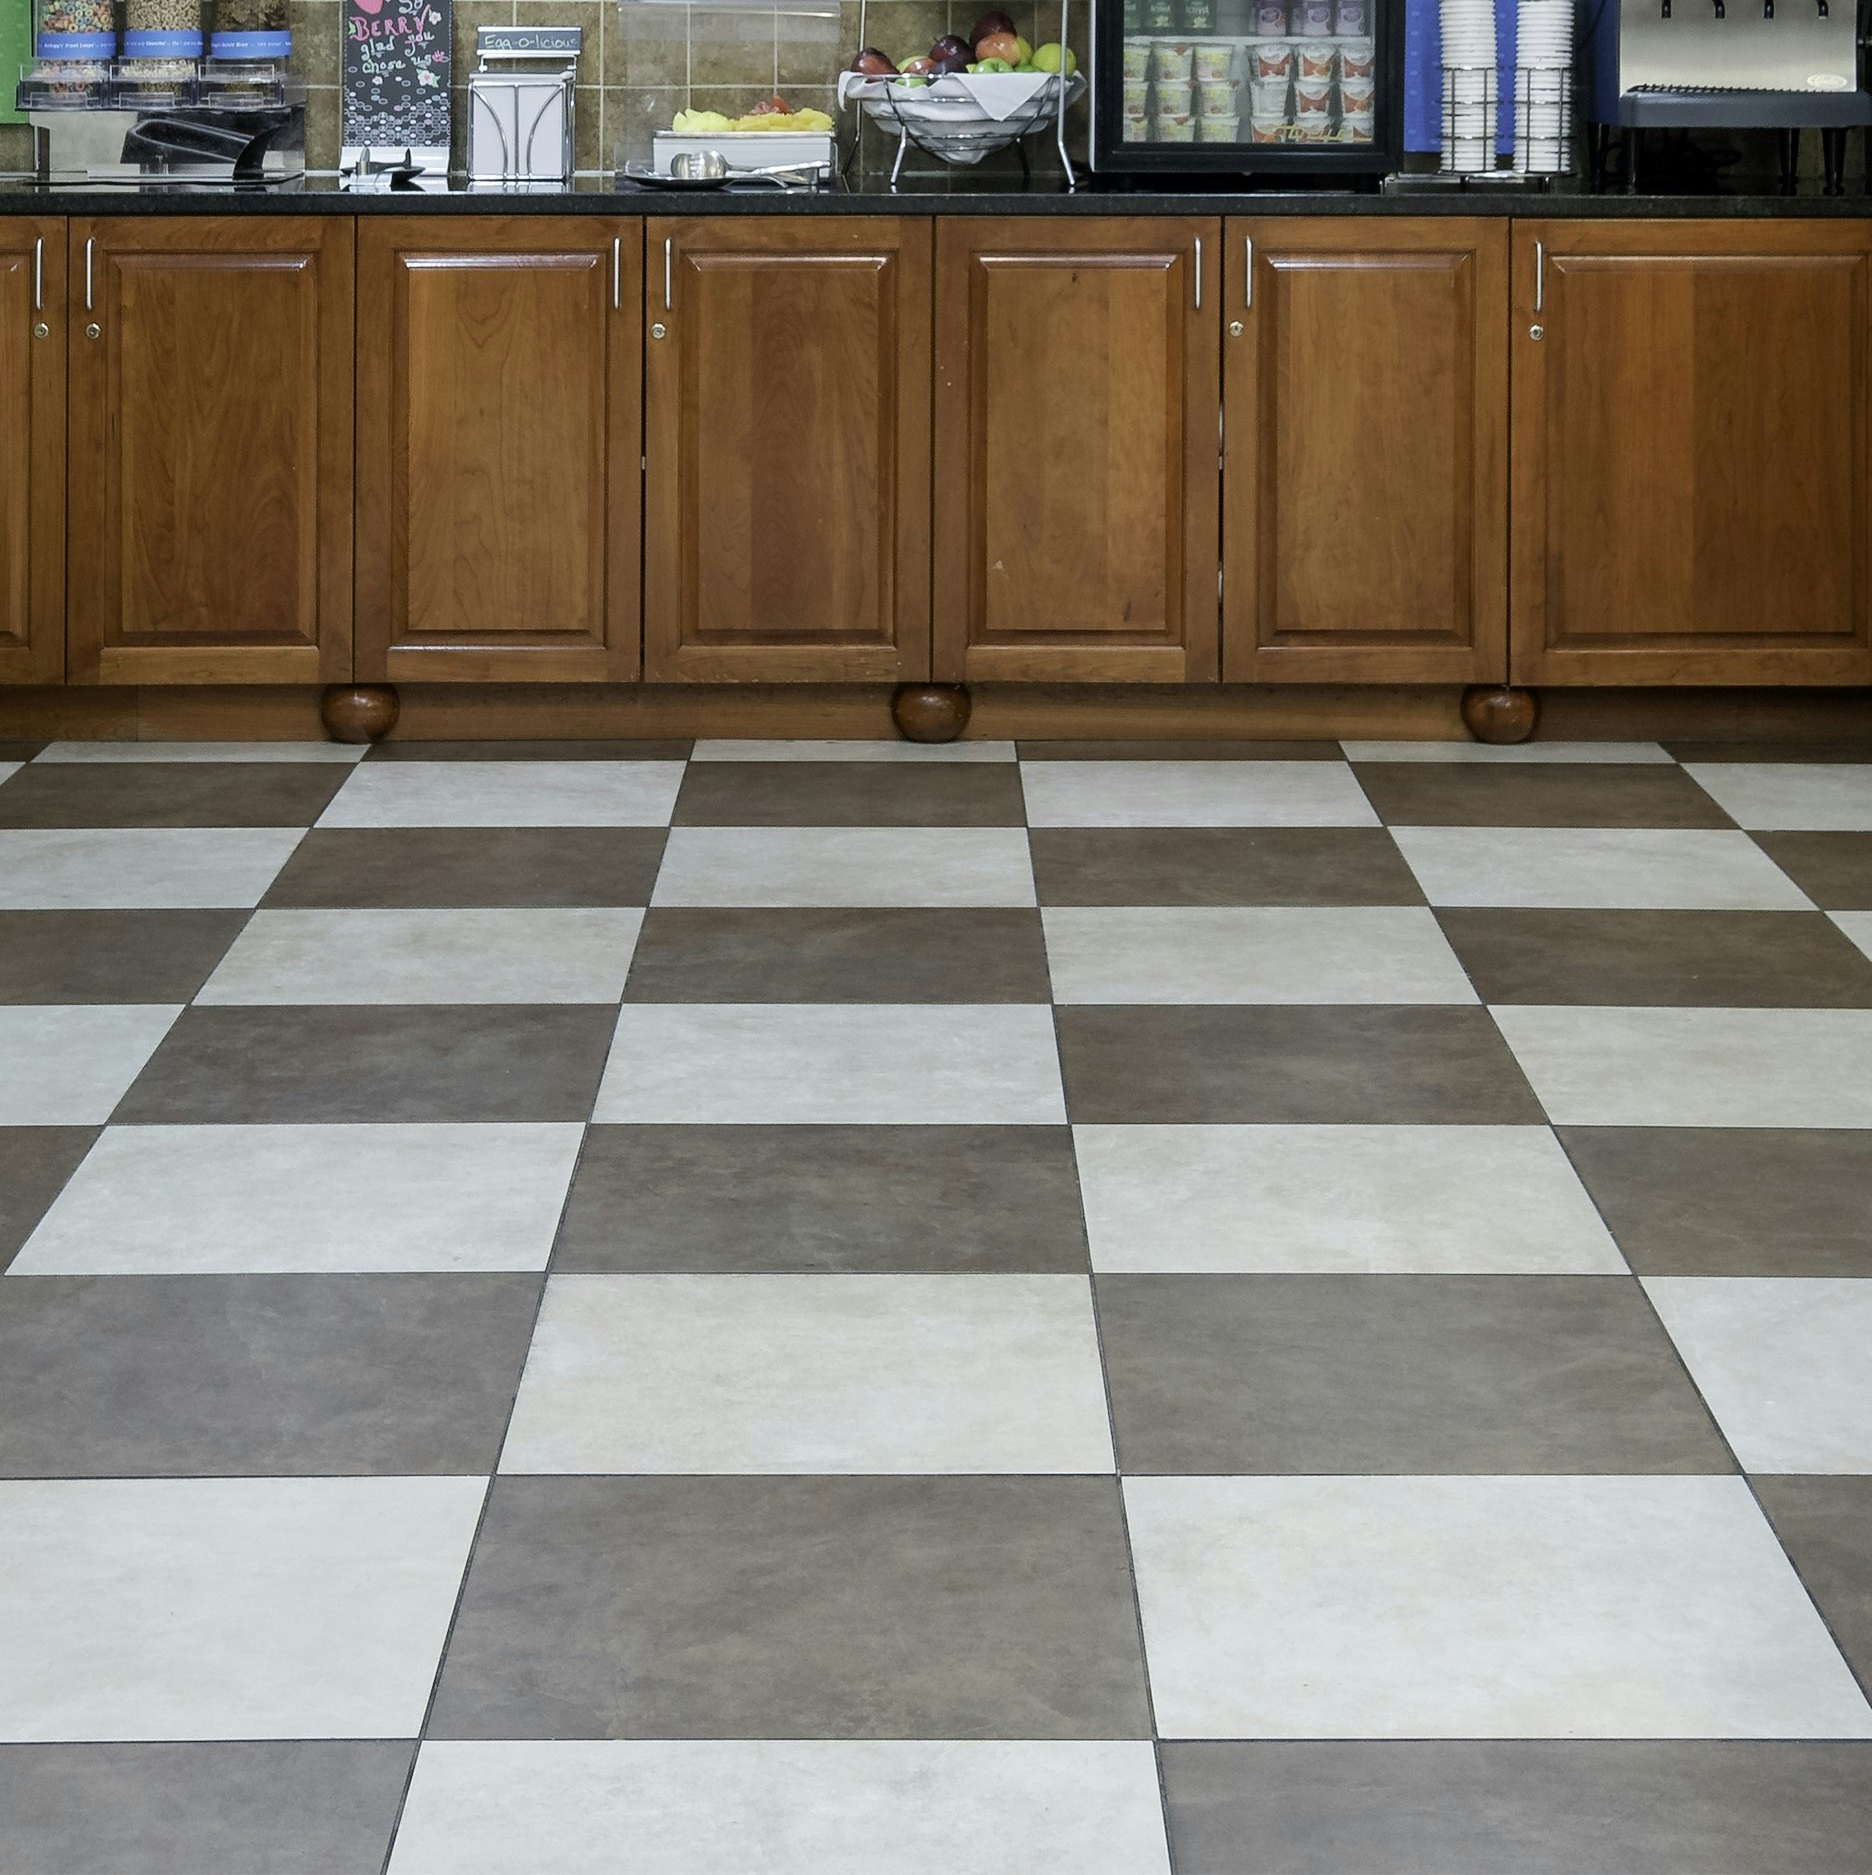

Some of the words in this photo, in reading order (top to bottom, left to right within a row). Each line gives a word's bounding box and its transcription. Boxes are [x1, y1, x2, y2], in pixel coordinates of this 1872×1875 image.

[349, 4, 431, 41] BERRY
[361, 35, 395, 61] glad
[362, 58, 406, 73] chose
[411, 53, 432, 67] us
